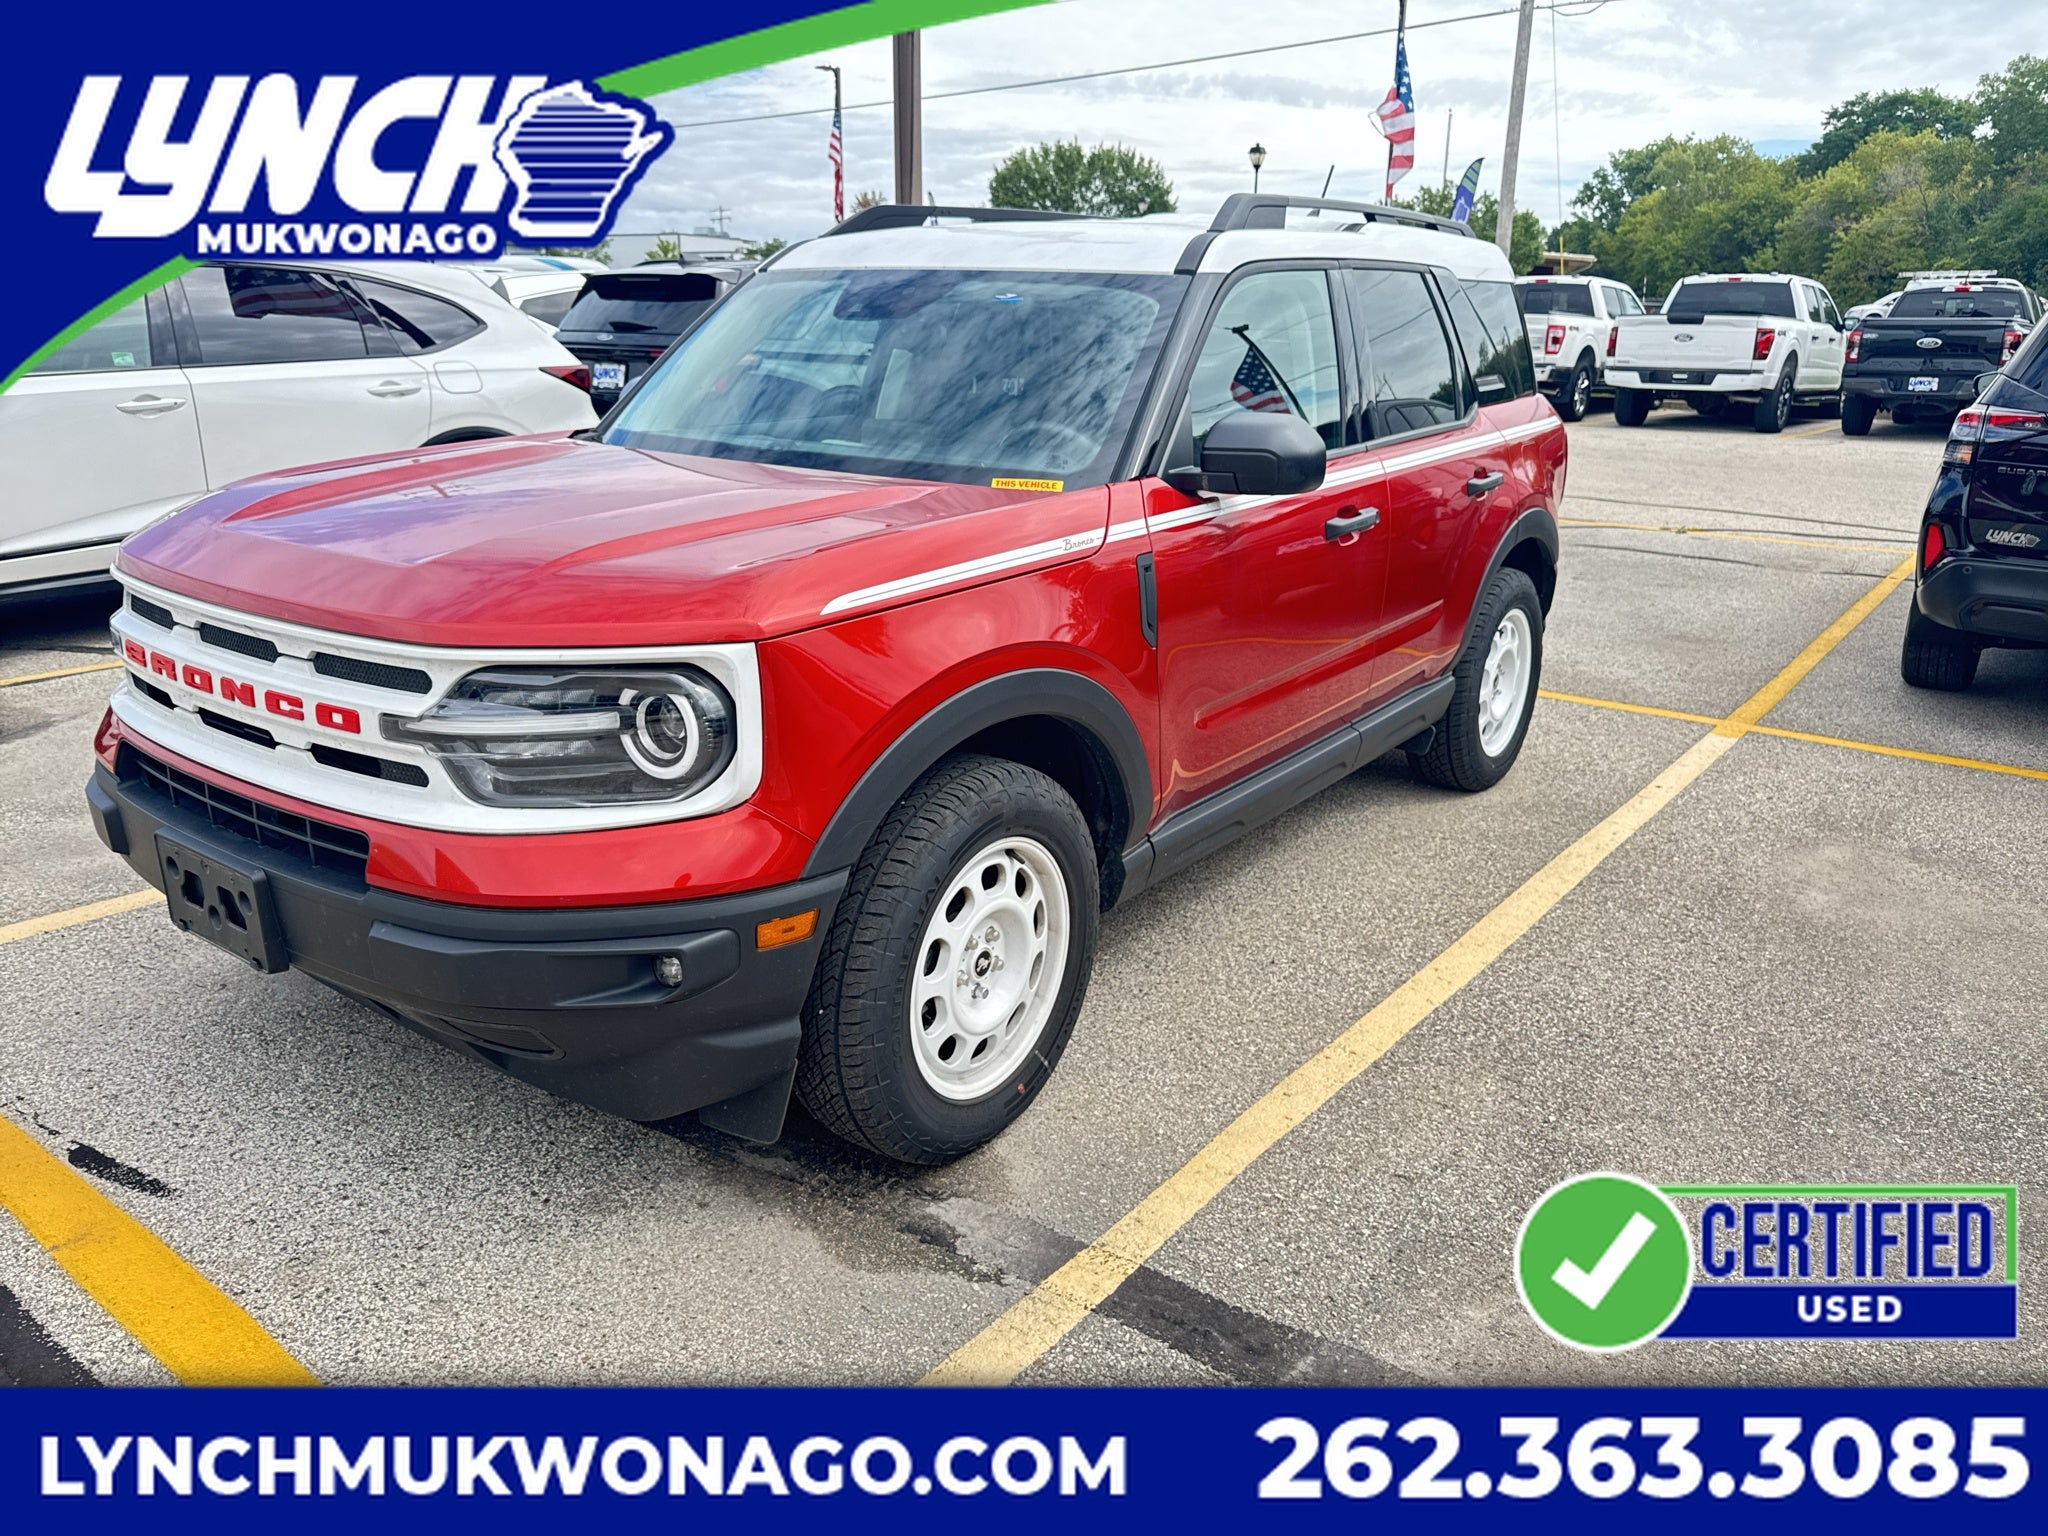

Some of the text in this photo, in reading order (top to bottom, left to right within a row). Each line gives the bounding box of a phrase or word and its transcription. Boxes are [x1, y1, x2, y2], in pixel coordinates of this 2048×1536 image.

[1998, 466, 2048, 477] SUBAR
[995, 480, 1058, 490] THIS VEHICLE
[1985, 529, 2026, 544] LYNCH
[1062, 538, 1095, 551] Bronco
[125, 638, 361, 734] BRONCO
